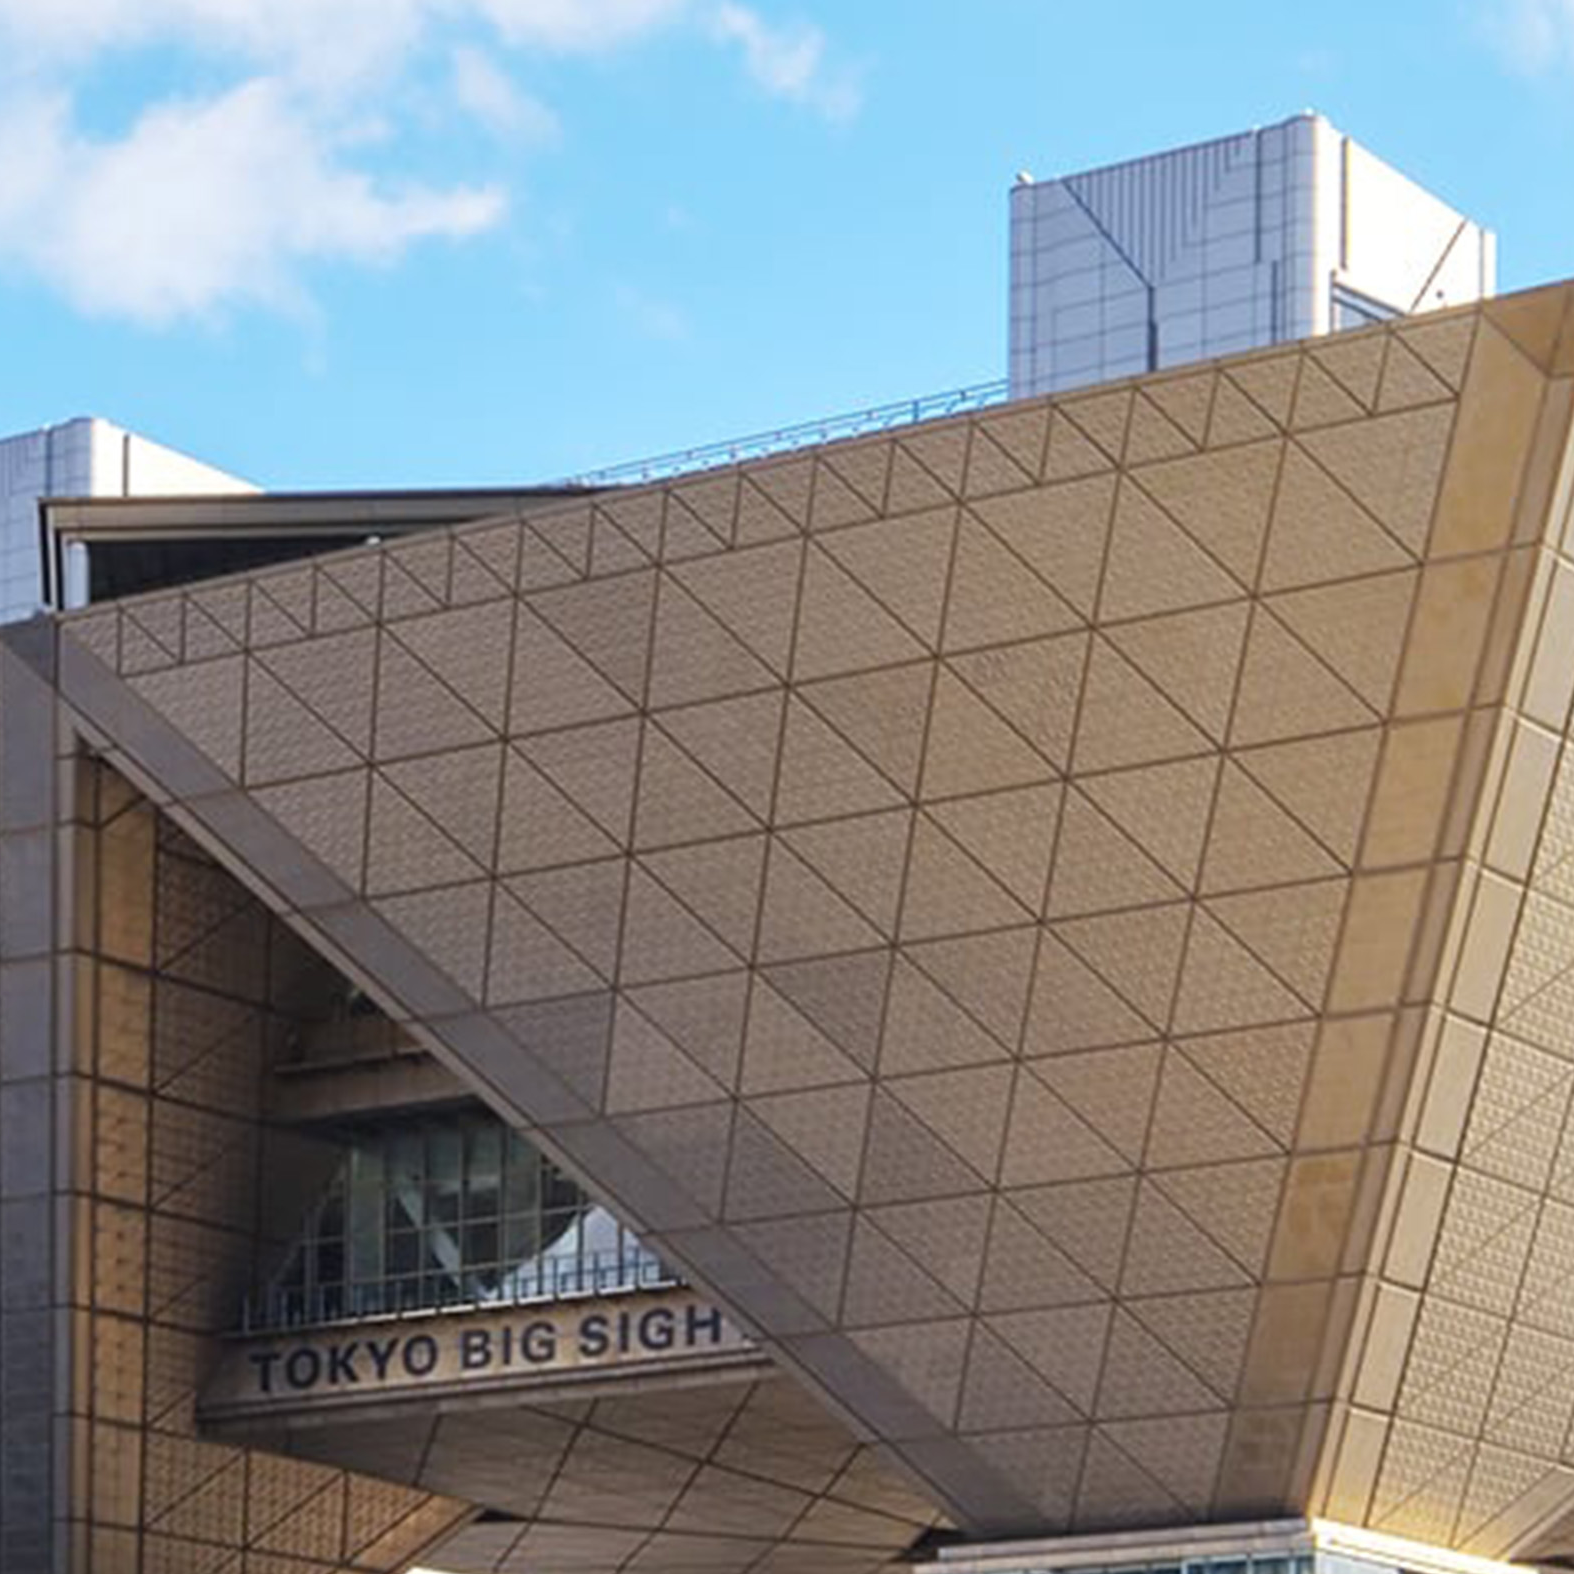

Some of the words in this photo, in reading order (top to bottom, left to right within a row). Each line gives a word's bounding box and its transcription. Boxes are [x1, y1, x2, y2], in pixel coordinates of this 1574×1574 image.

[248, 1334, 439, 1393] TOKYO
[460, 1321, 558, 1370] BIG
[578, 1304, 722, 1358] SIGH
